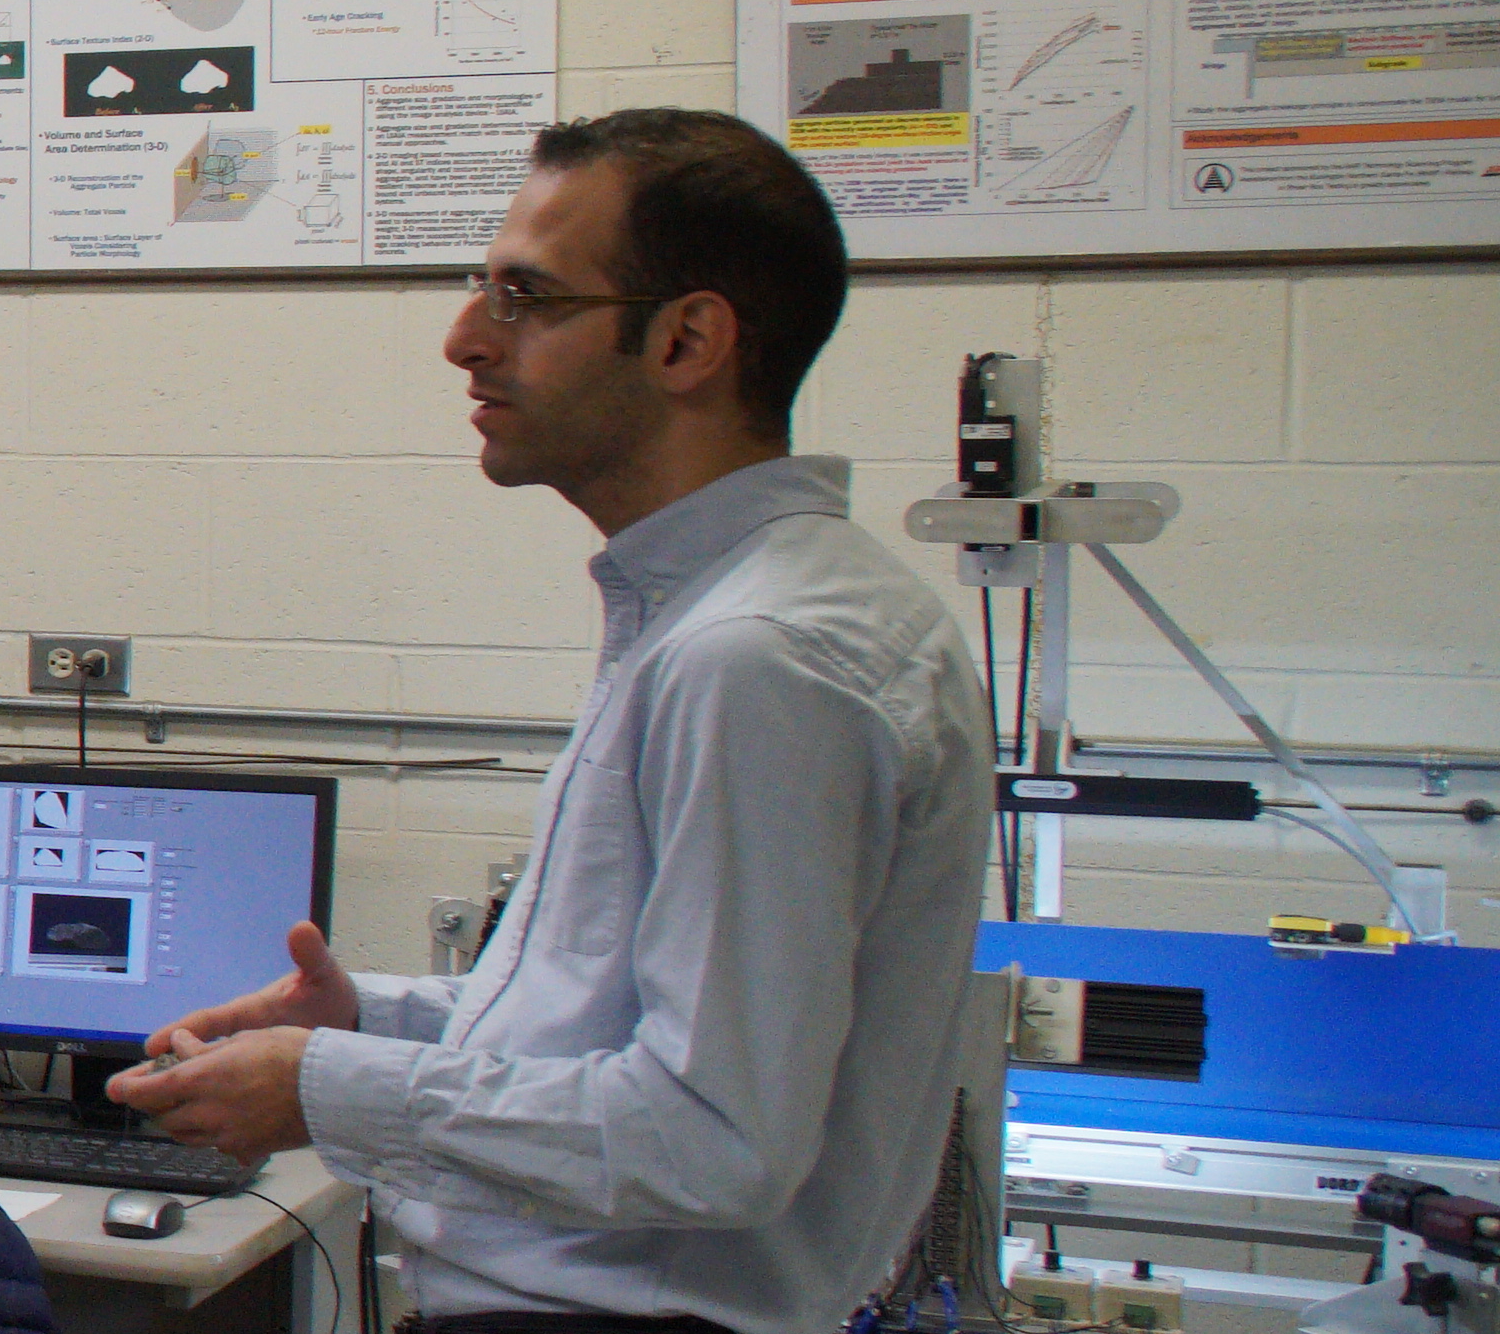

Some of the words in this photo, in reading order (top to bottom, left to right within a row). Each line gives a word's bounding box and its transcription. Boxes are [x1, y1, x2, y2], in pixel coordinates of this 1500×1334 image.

[307, 13, 327, 23] Early
[330, 12, 345, 22] Age
[347, 10, 384, 21] Cracking
[51, 37, 79, 46] Surface
[82, 36, 110, 45] Texture
[112, 35, 133, 44] Index
[367, 85, 378, 95] 5.
[382, 83, 454, 95] Conclusions
[44, 130, 81, 140] Volume
[84, 129, 102, 139] and
[105, 128, 143, 138] Surface
[45, 143, 68, 153] Area
[70, 142, 141, 153] Determination
[143, 141, 169, 153] (3-D)
[57, 1041, 88, 1054] DELL
